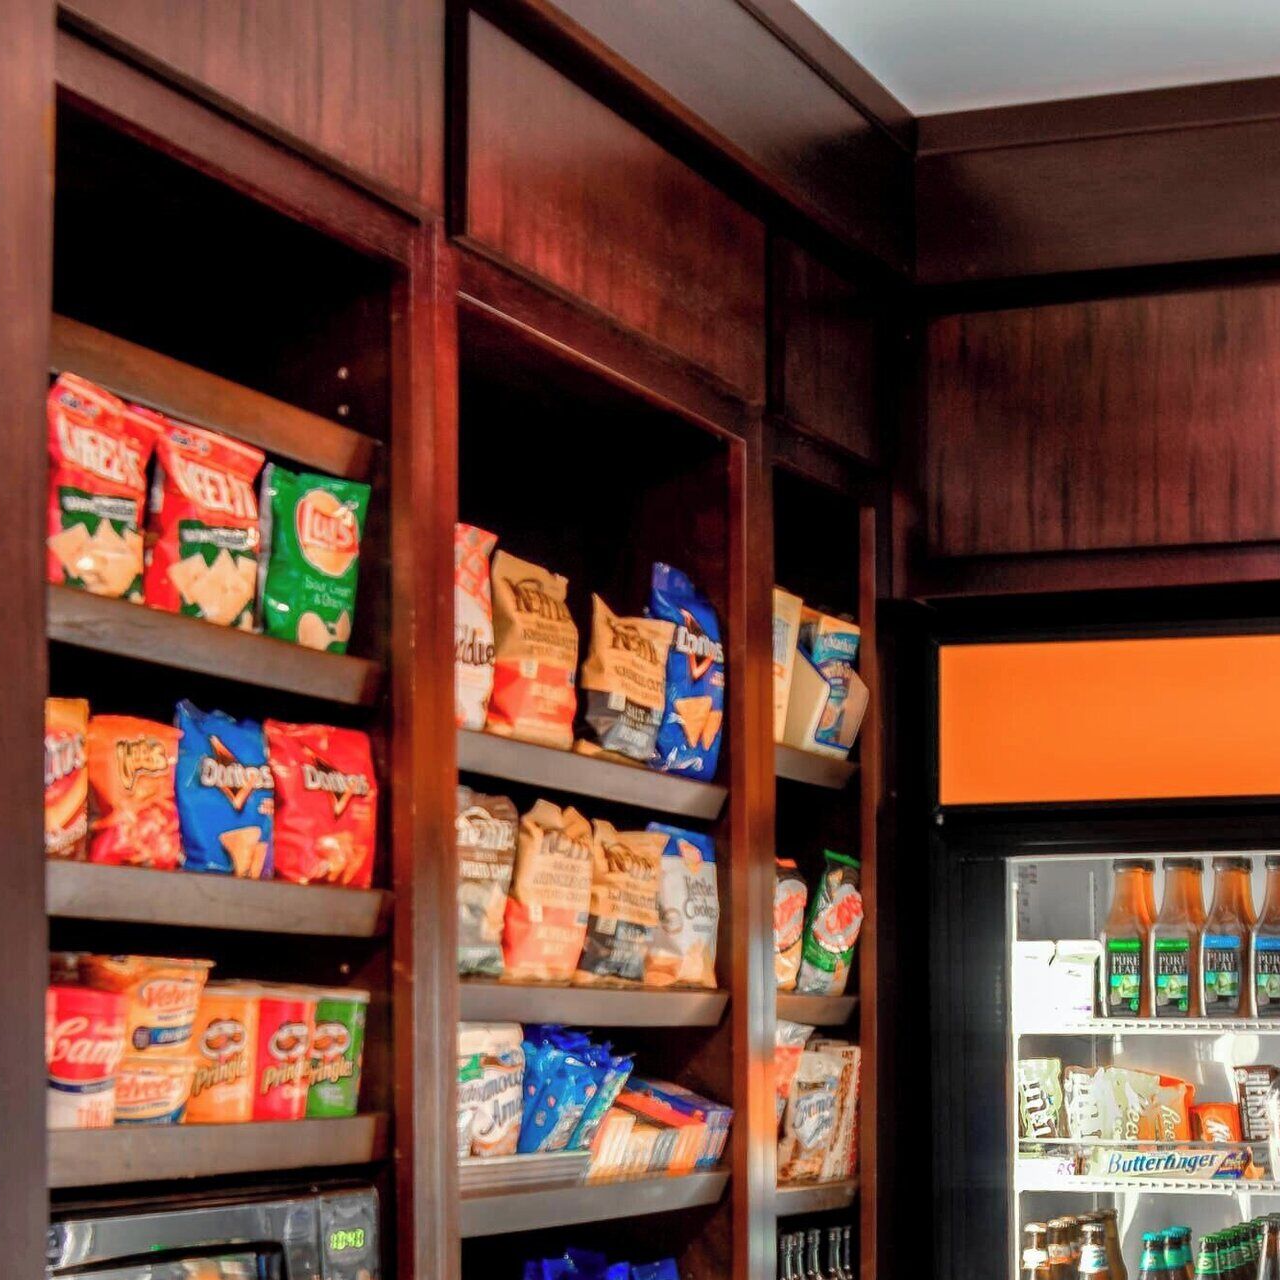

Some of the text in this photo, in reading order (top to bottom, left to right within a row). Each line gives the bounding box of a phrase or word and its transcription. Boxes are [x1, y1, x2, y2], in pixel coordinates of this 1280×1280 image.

[200, 757, 274, 789] Doritos
[304, 764, 369, 796] Doritos
[1113, 955, 1140, 966] PURE
[1107, 1151, 1220, 1175] Butterfinger
